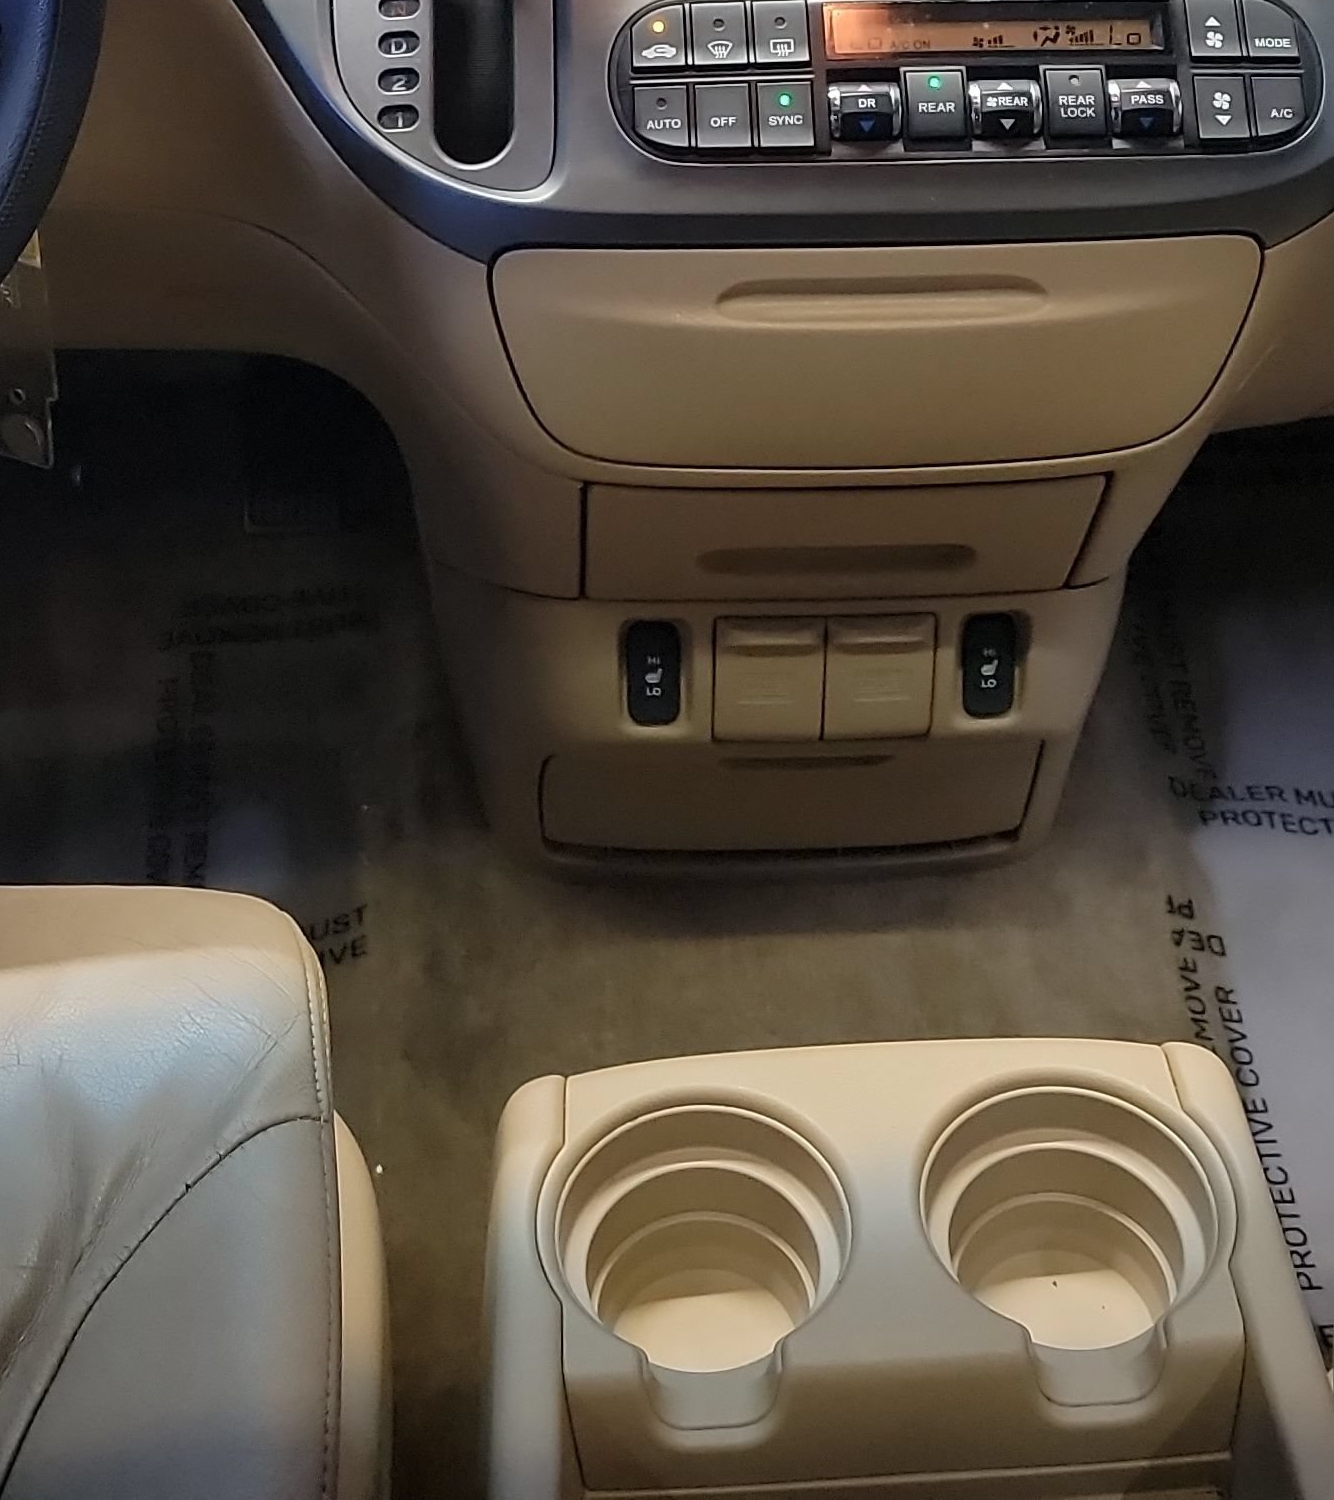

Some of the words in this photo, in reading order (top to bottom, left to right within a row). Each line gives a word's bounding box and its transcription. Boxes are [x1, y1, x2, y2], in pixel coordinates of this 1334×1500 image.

[392, 38, 407, 53] D
[1254, 37, 1292, 48] MODE
[392, 75, 407, 90] 2
[858, 98, 876, 109] DR
[998, 97, 1029, 107] REAR
[1058, 95, 1095, 107] REAR
[1130, 95, 1164, 105] PASS
[918, 102, 955, 113] REAR
[1061, 106, 1096, 118] LOCK
[1270, 108, 1293, 119] A/C
[646, 118, 682, 130] AUTO
[710, 116, 736, 127] OFF
[768, 115, 803, 126] SYNC
[1168, 776, 1285, 803] DEALER
[309, 903, 367, 941] UST
[1214, 984, 1259, 1088] COVER
